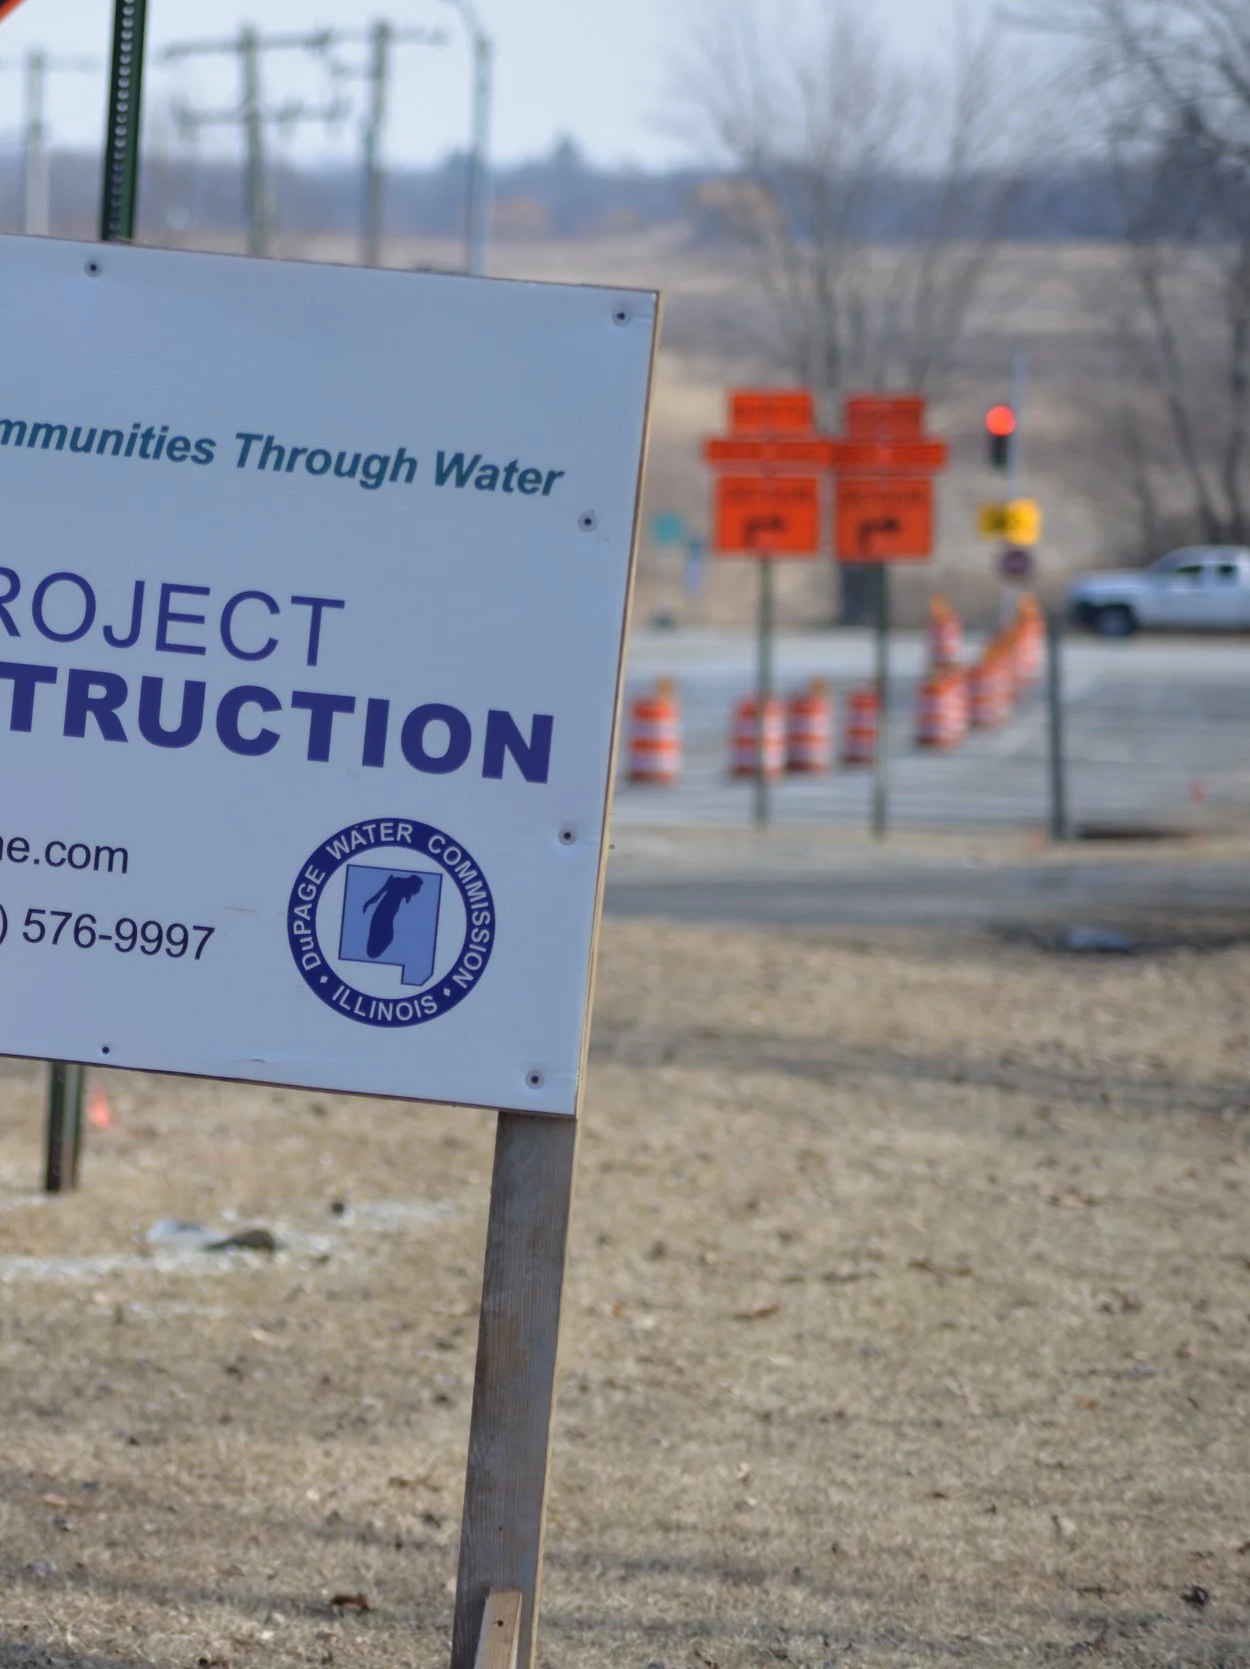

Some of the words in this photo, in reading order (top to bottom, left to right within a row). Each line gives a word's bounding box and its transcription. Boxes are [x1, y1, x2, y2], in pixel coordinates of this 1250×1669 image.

[234, 431, 419, 490] Through
[434, 450, 566, 497] Water
[21, 908, 216, 960] 576-9997
[325, 822, 414, 861] WATER
[427, 834, 491, 989] COMMISSION
[332, 994, 438, 1022] ILLINOIS
